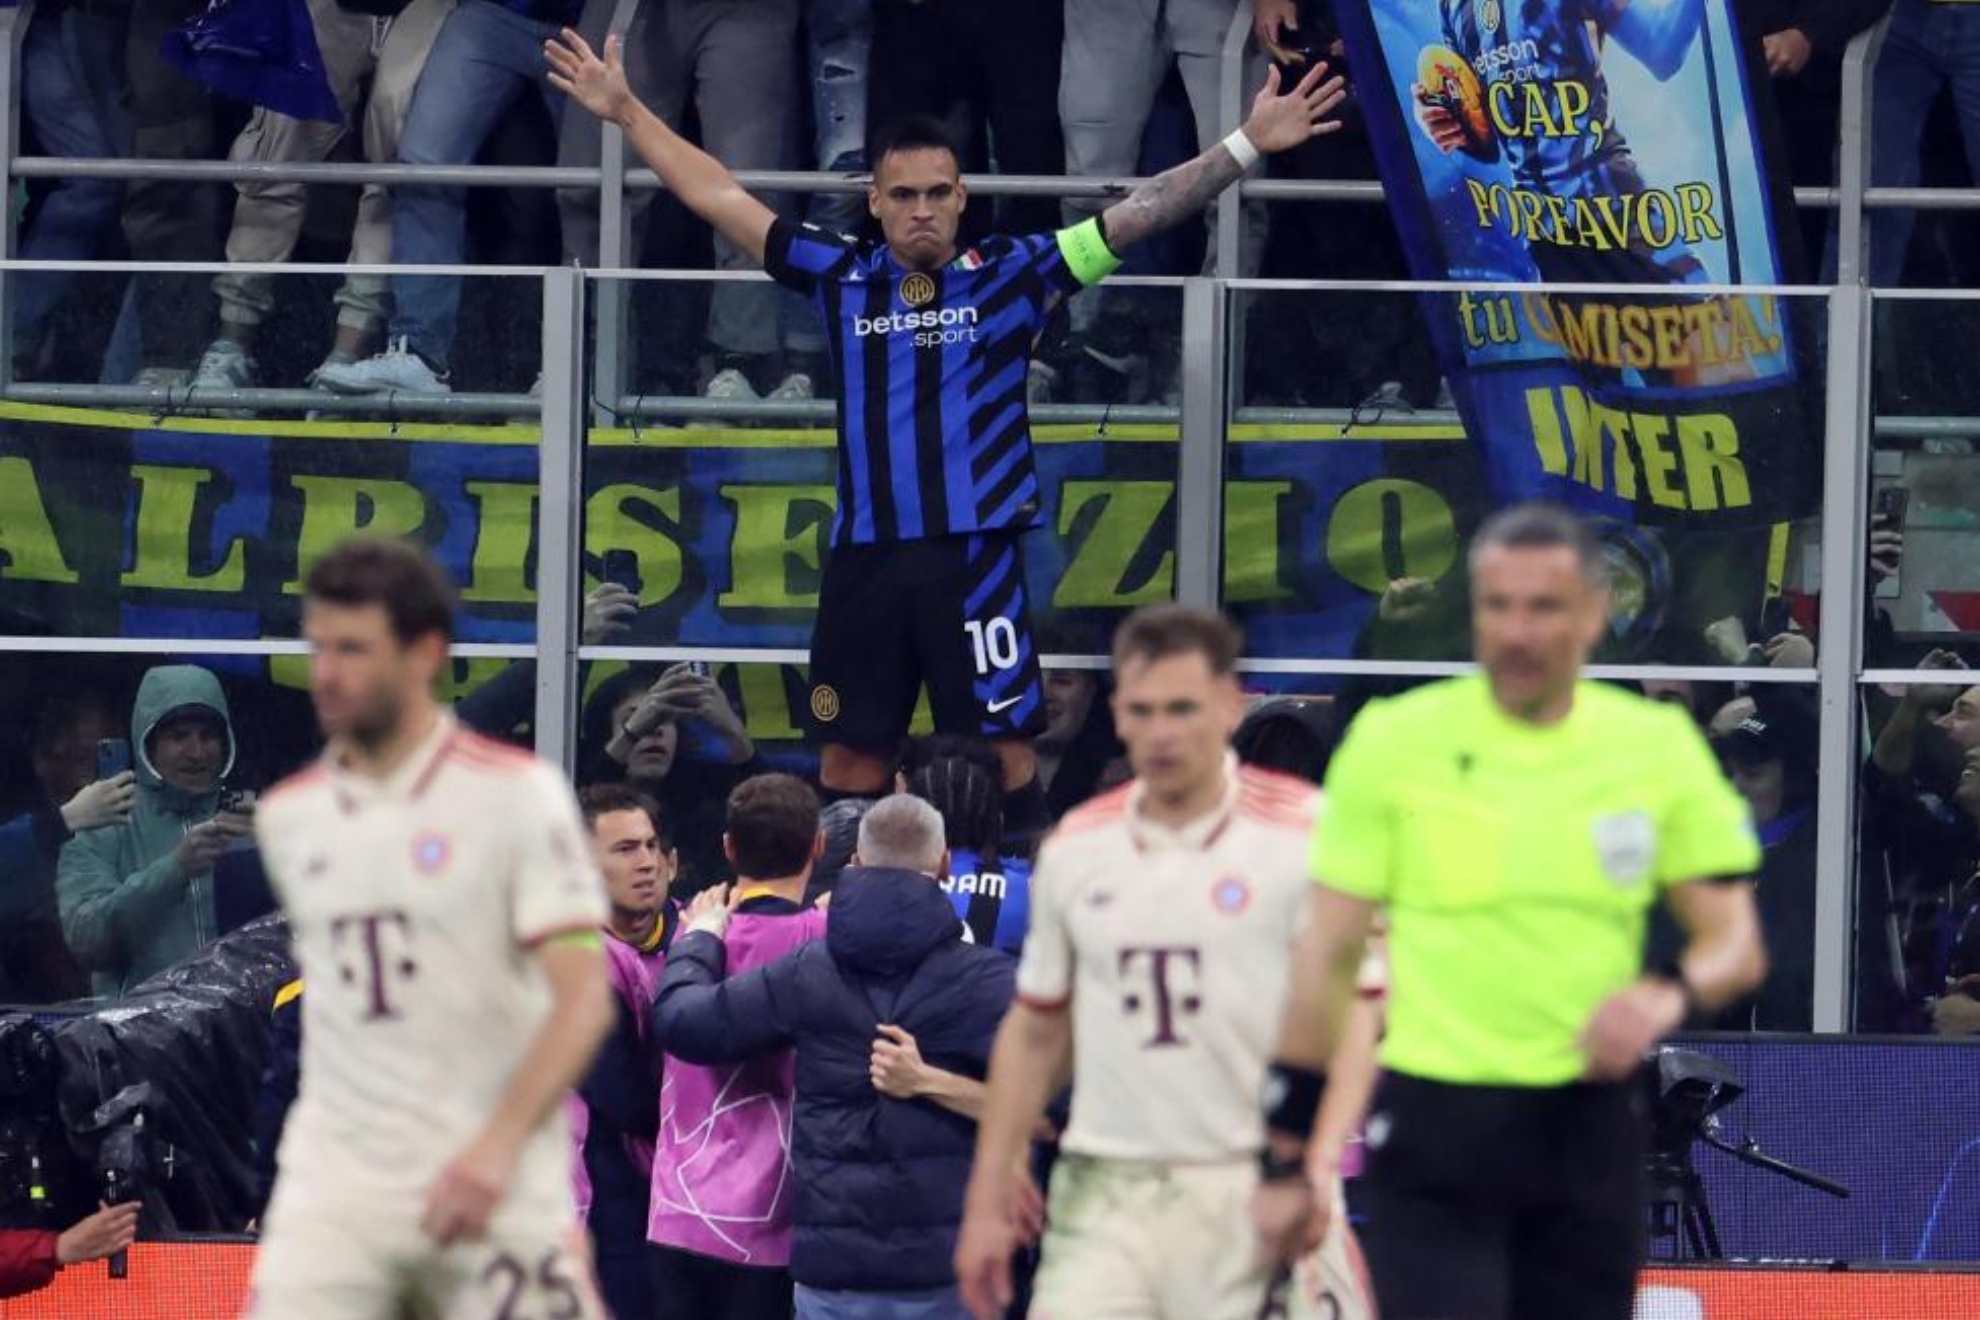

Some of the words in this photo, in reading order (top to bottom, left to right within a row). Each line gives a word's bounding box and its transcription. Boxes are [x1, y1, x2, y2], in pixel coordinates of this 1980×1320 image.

[1488, 80, 1603, 151] CAP,
[854, 306, 978, 337] betsson
[1458, 290, 1518, 347] tu
[1526, 385, 1752, 511] INTER
[964, 616, 1018, 674] 10
